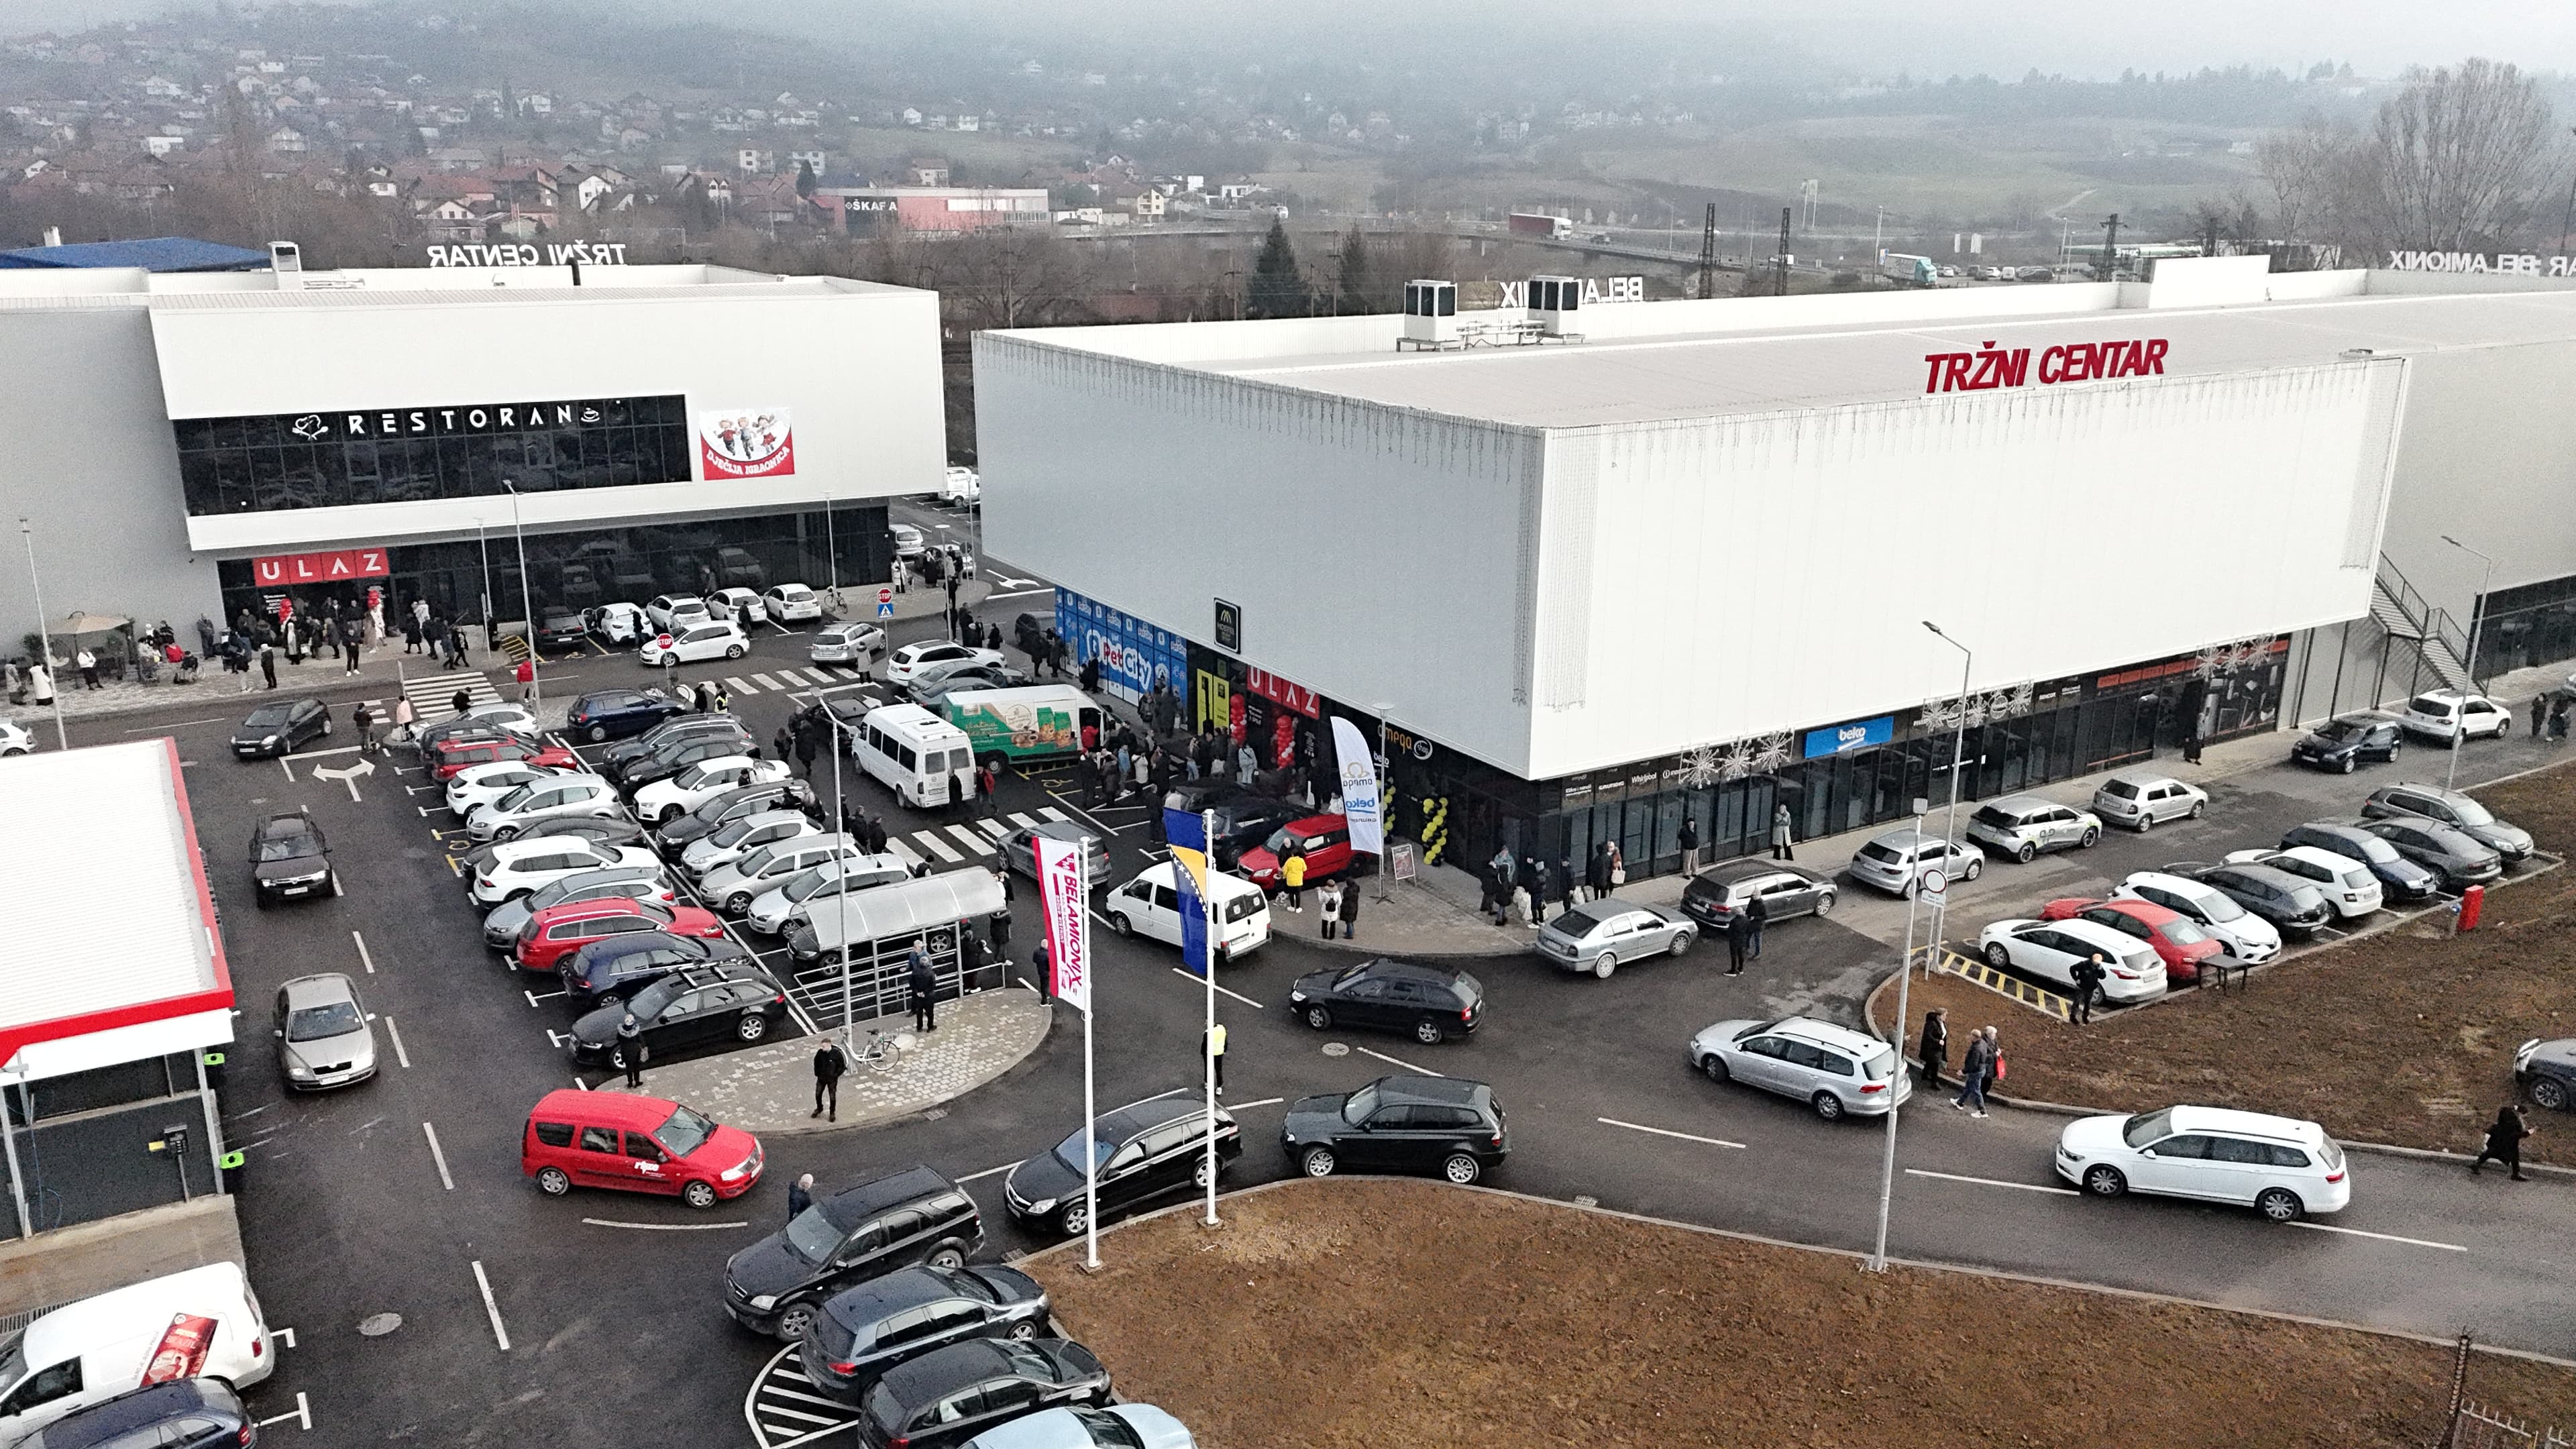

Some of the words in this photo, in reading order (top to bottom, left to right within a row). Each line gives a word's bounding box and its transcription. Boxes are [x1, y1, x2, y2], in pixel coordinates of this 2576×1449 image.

[1924, 341, 2031, 394] TRŽNI
[2038, 338, 2169, 384] CENTAR
[347, 405, 572, 434] RESTORAN
[744, 445, 790, 476] IGRAONICA
[262, 553, 382, 580] ULAZ
[1102, 639, 1151, 688] PetCity
[1250, 665, 1316, 714] ULAZ
[1839, 727, 1866, 741] beko
[1373, 751, 1390, 765] beo
[1064, 874, 1082, 987] BELAMIONIX
